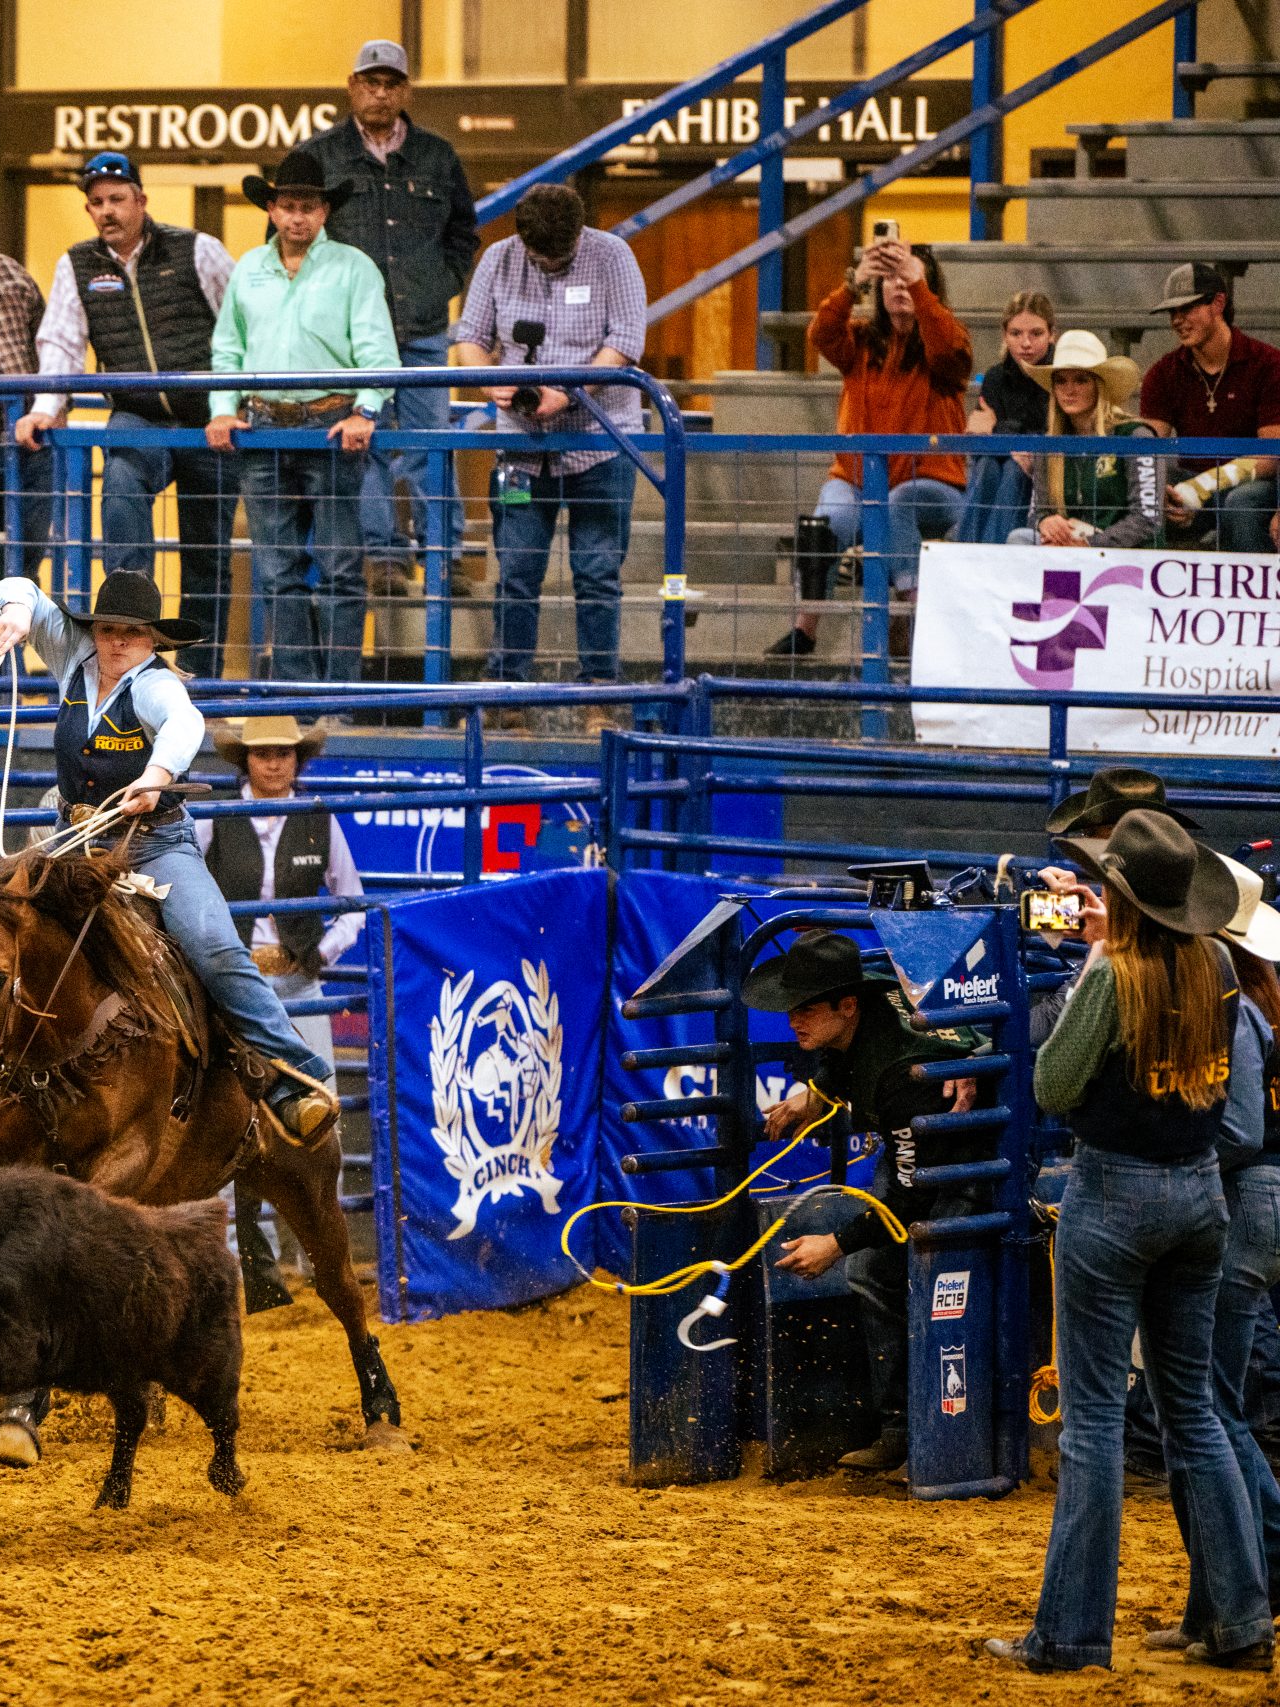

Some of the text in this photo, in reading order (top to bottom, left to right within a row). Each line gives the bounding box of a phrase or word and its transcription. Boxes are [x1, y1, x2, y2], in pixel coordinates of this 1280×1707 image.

[55, 103, 337, 149] RESTROOMS
[622, 96, 938, 143] EXHIBT HALL
[1150, 559, 1280, 601] CHRI
[1148, 607, 1280, 647] MOTH
[1143, 655, 1273, 695] Hospital
[95, 739, 144, 751] RODEO
[1142, 708, 1270, 745] Sulphur
[473, 1153, 532, 1191] CINCH
[935, 1293, 965, 1307] RC19
[937, 1280, 965, 1291] Priefert
